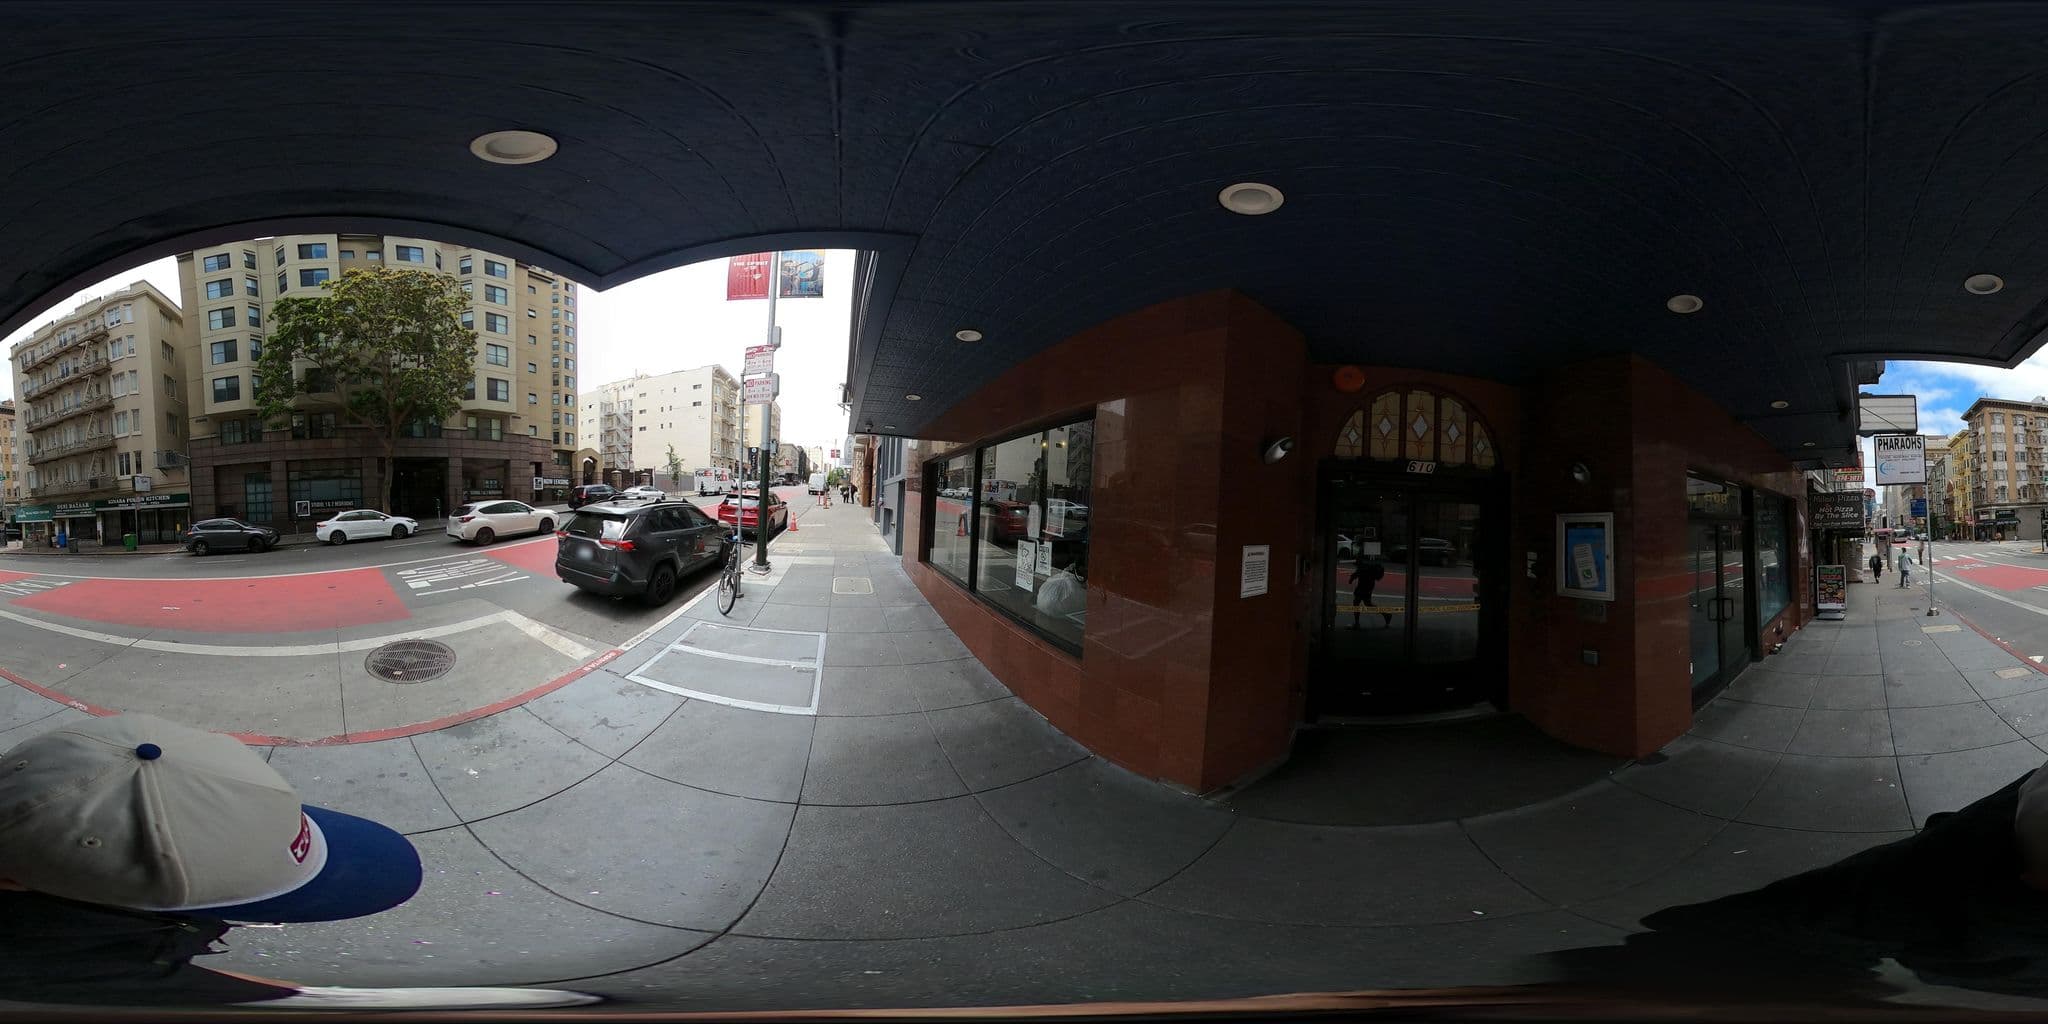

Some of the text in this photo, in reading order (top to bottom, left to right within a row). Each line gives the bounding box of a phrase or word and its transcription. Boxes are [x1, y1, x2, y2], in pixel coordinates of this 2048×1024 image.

[1877, 437, 1922, 451] PHARAOHS
[1409, 461, 1434, 473] 610
[1814, 513, 1825, 521] By
